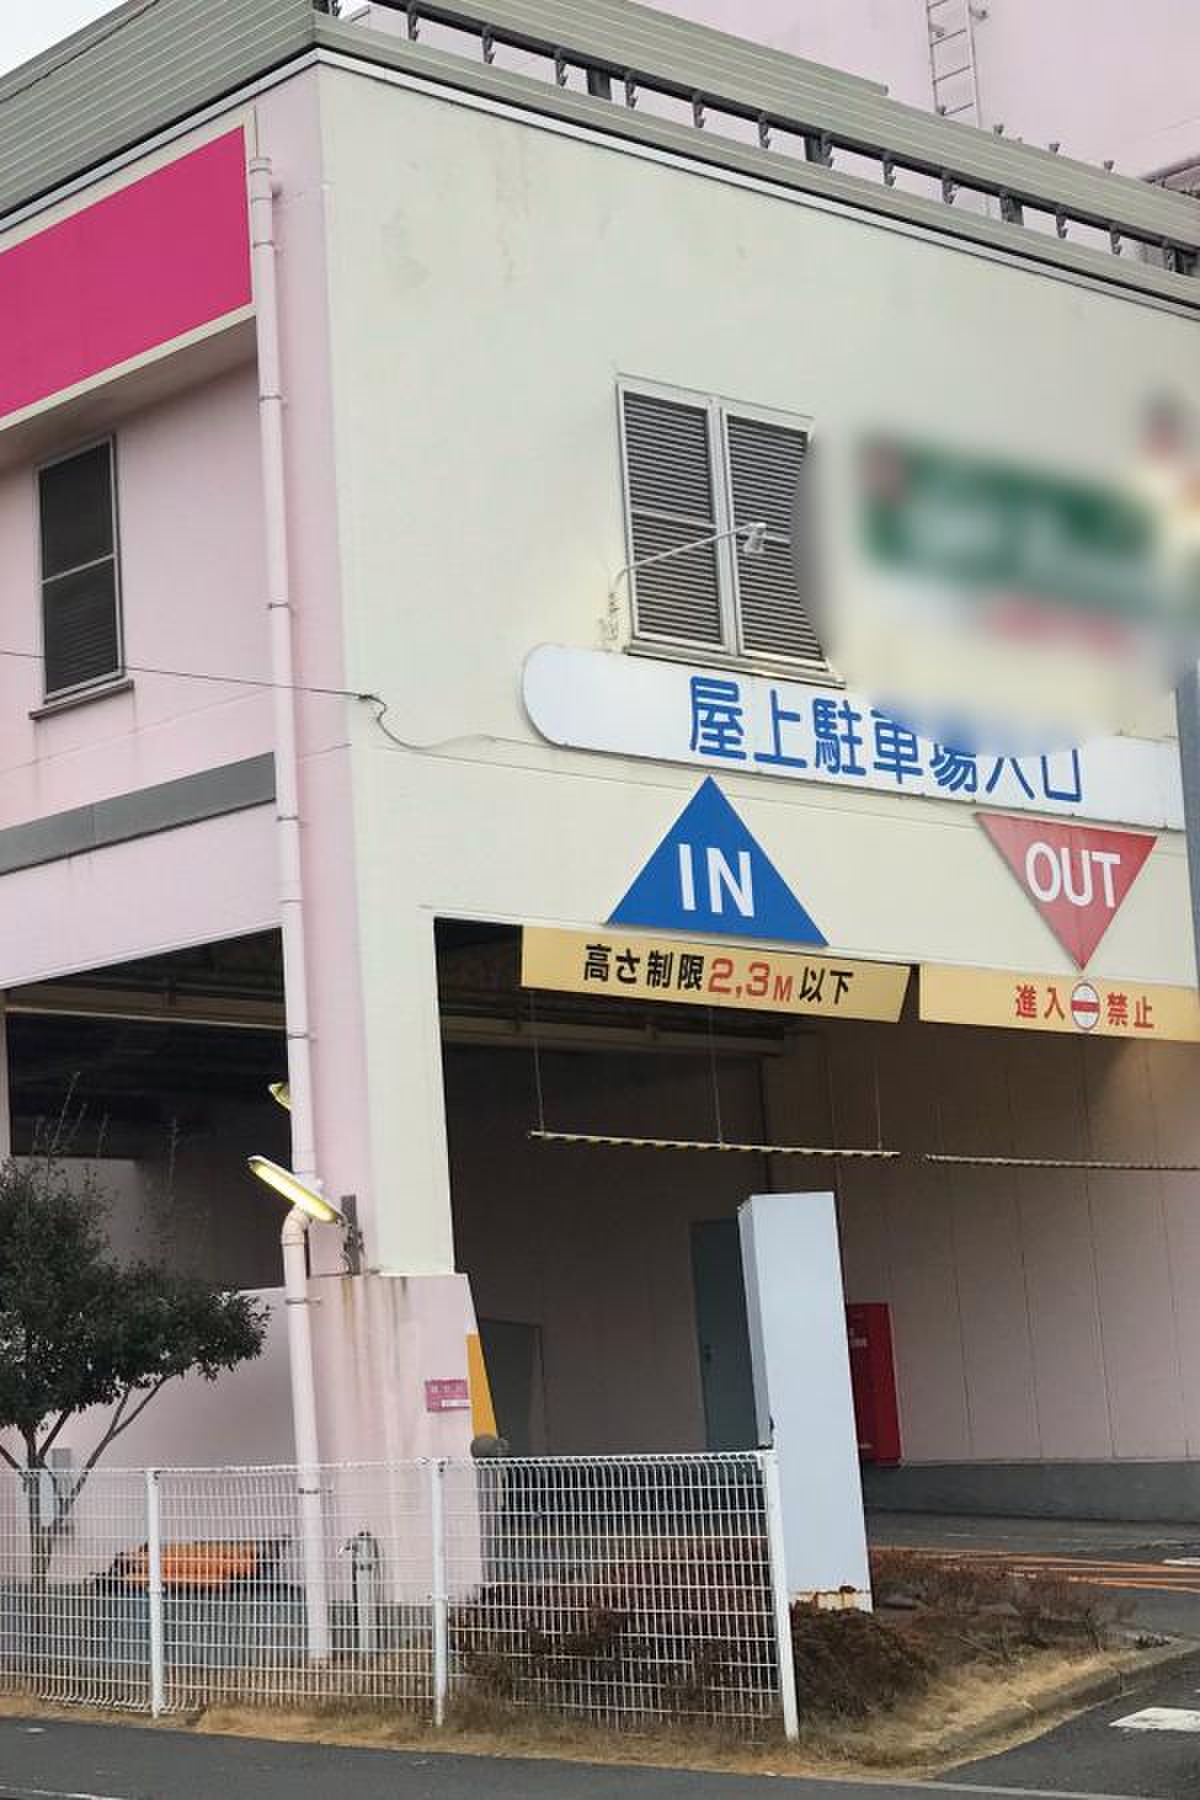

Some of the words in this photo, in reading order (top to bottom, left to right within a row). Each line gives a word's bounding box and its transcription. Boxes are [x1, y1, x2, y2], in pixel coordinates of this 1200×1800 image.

[679, 843, 755, 917] IN
[1025, 842, 1121, 908] OUT
[1015, 984, 1065, 1021] 進入
[1107, 991, 1154, 1029] 禁止
